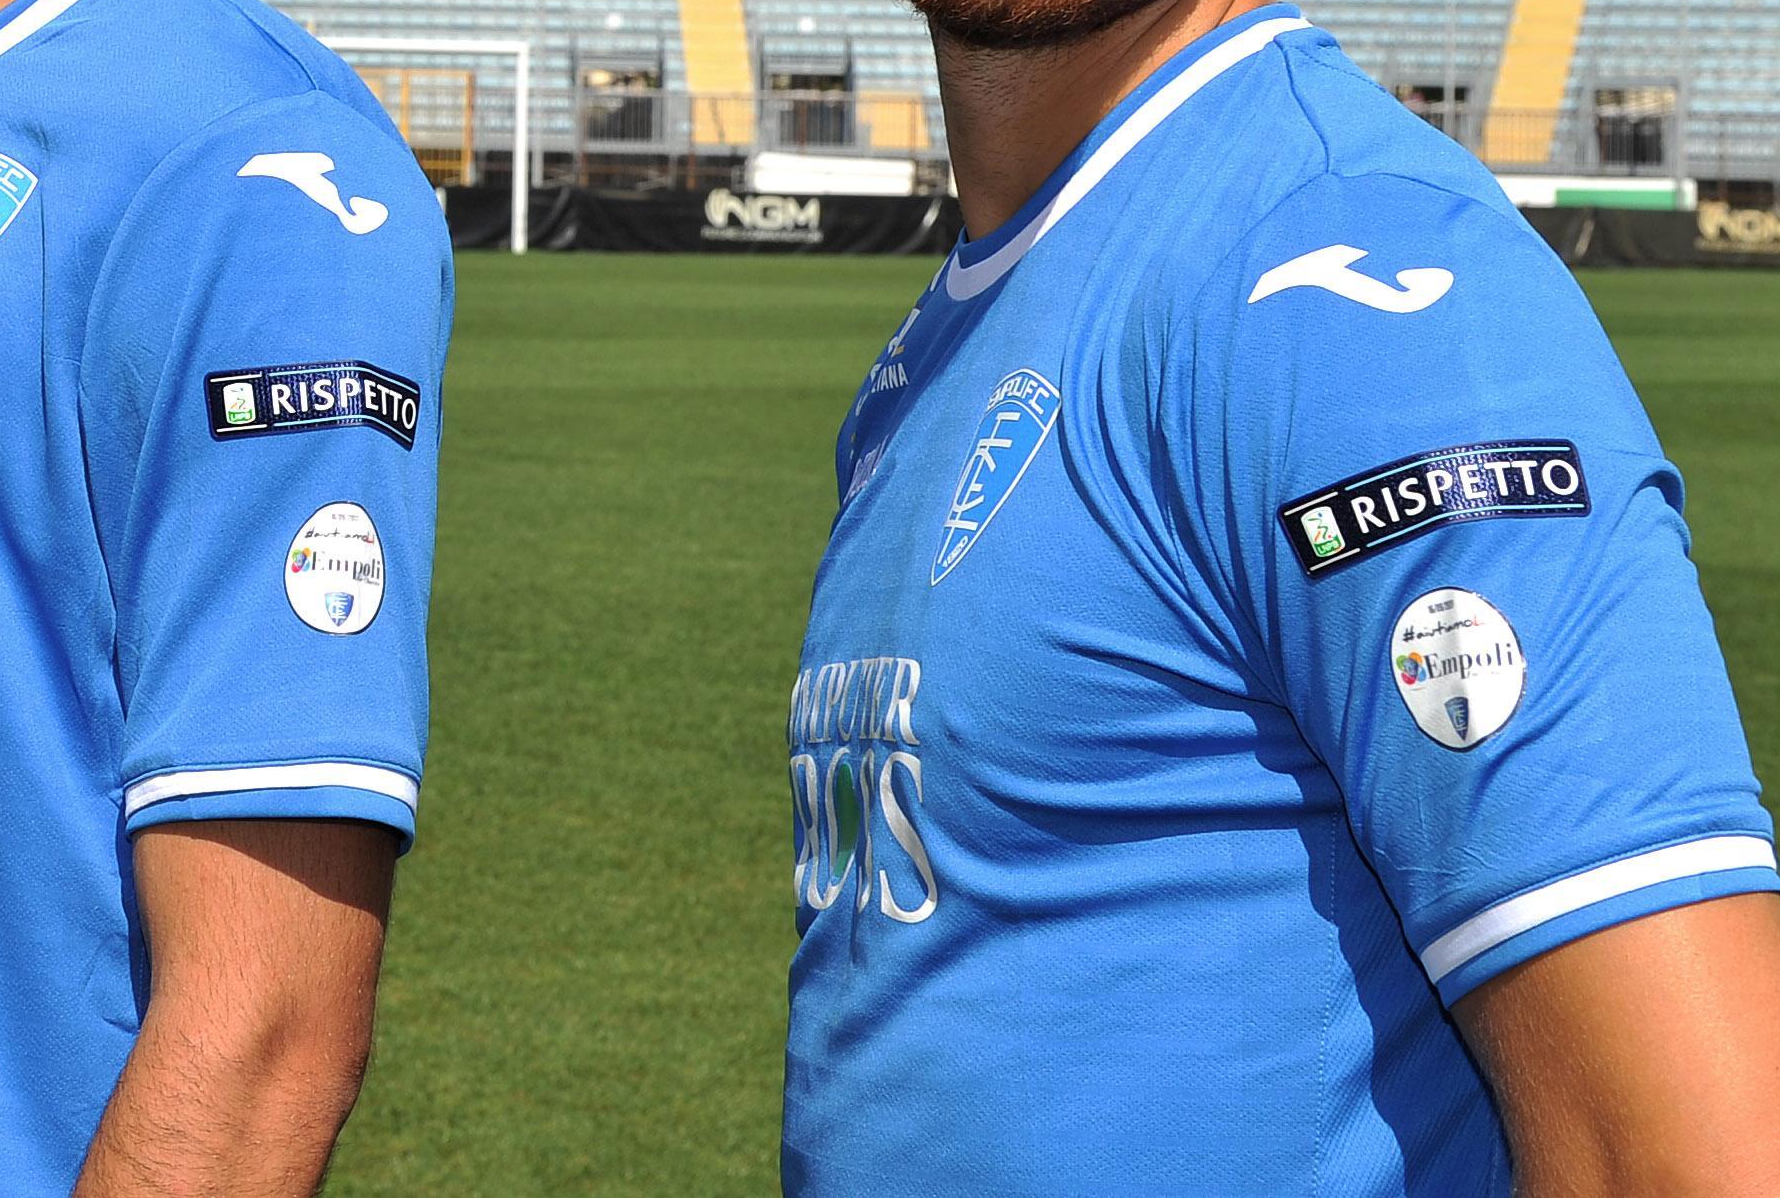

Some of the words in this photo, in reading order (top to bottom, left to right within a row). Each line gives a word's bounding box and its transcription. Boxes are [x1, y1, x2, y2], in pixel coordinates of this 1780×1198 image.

[271, 377, 417, 430] RISPETTO
[1351, 459, 1580, 534] RISPETTO
[1423, 642, 1514, 680] Empoli
